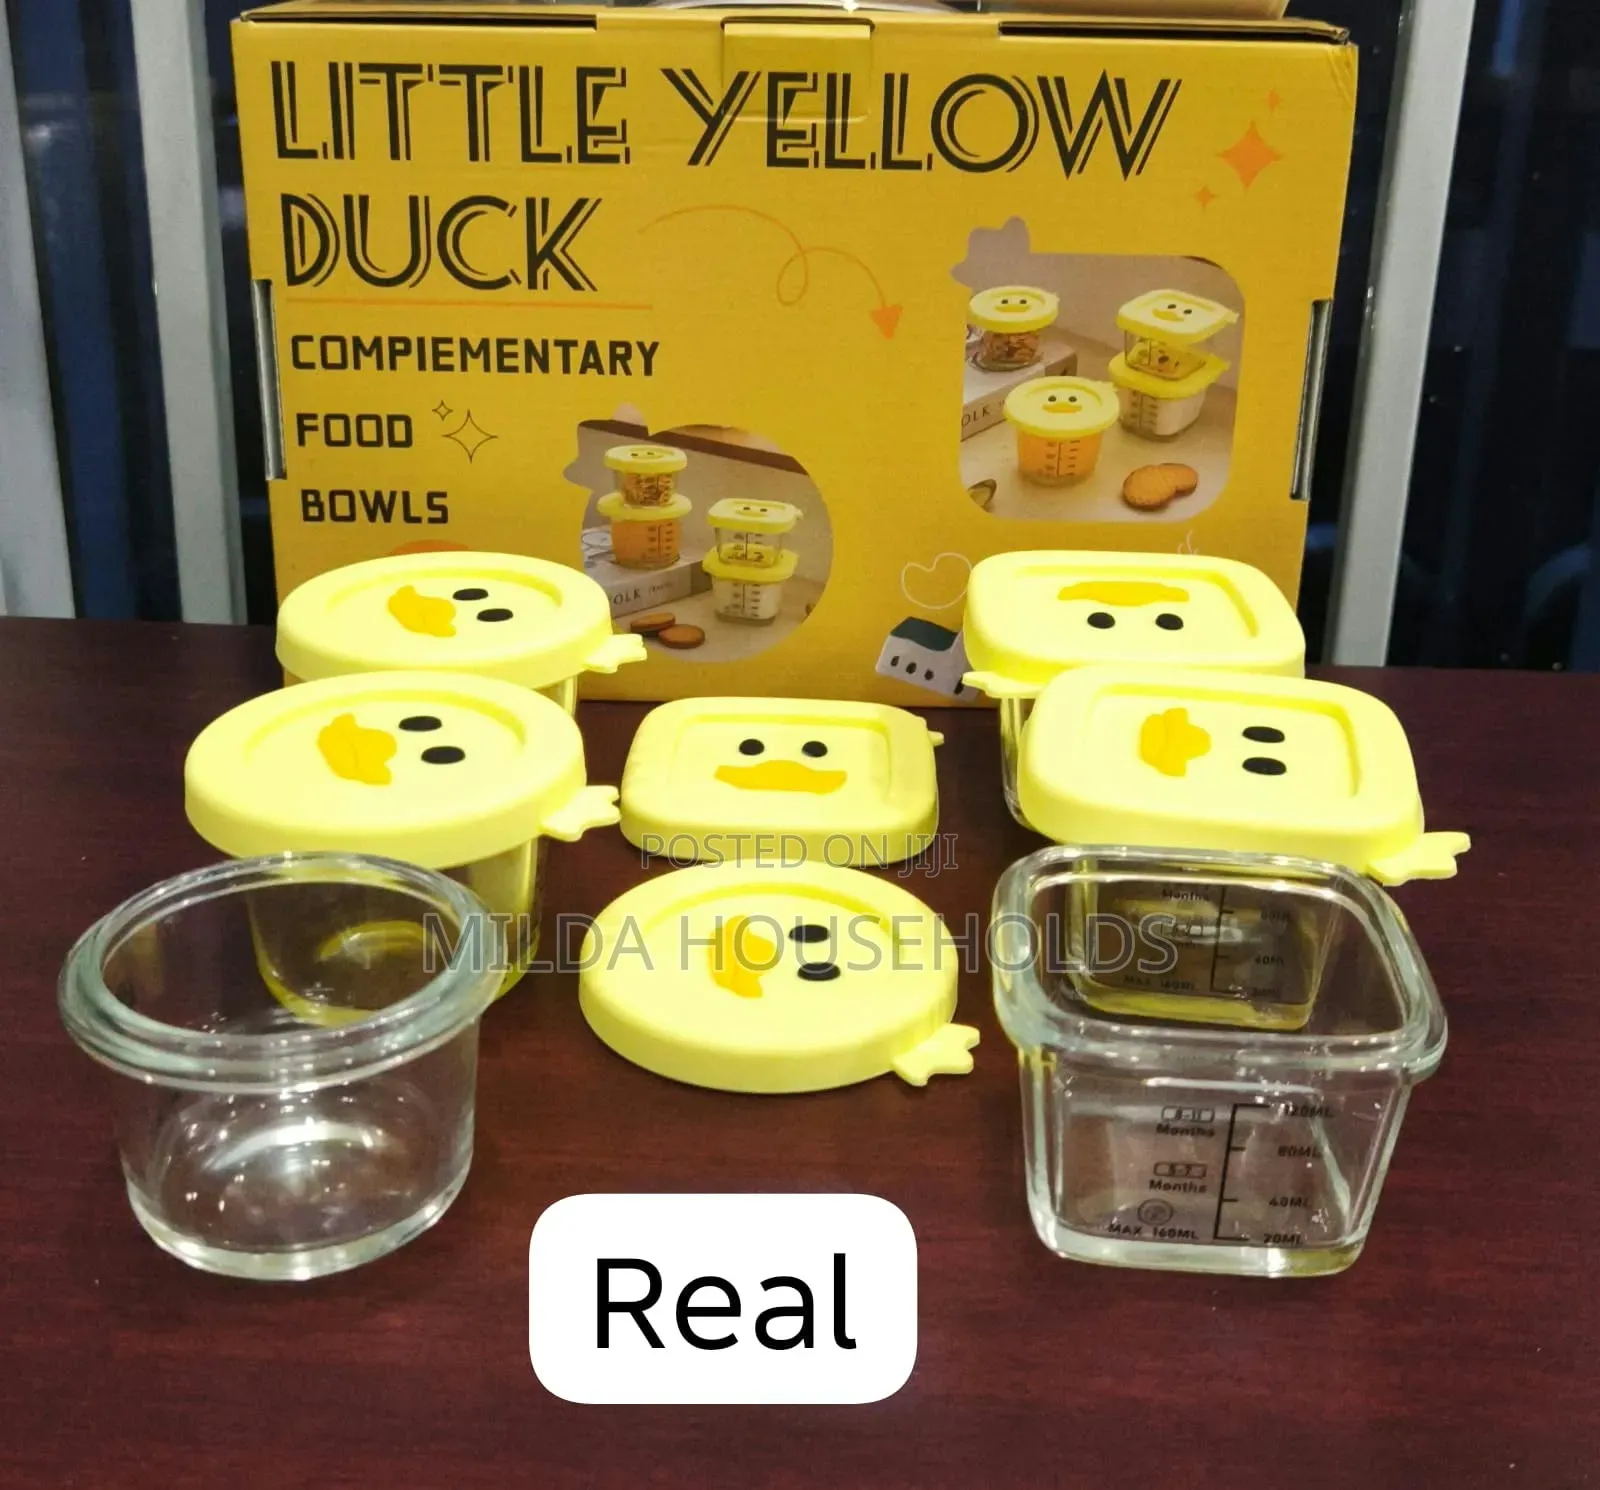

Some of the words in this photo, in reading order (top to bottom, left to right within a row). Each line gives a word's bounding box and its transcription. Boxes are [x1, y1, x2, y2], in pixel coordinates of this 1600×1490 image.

[270, 60, 631, 165] LITTLE
[660, 68, 1183, 182] YELLOW
[280, 192, 603, 292] DUCK
[291, 334, 661, 377] COMPIEMENTARY
[296, 413, 413, 449] FOOD
[301, 490, 450, 525] BOWLS
[1155, 1122, 1216, 1138] Months
[1148, 1179, 1209, 1194] Months
[1108, 1223, 1143, 1235] MAX
